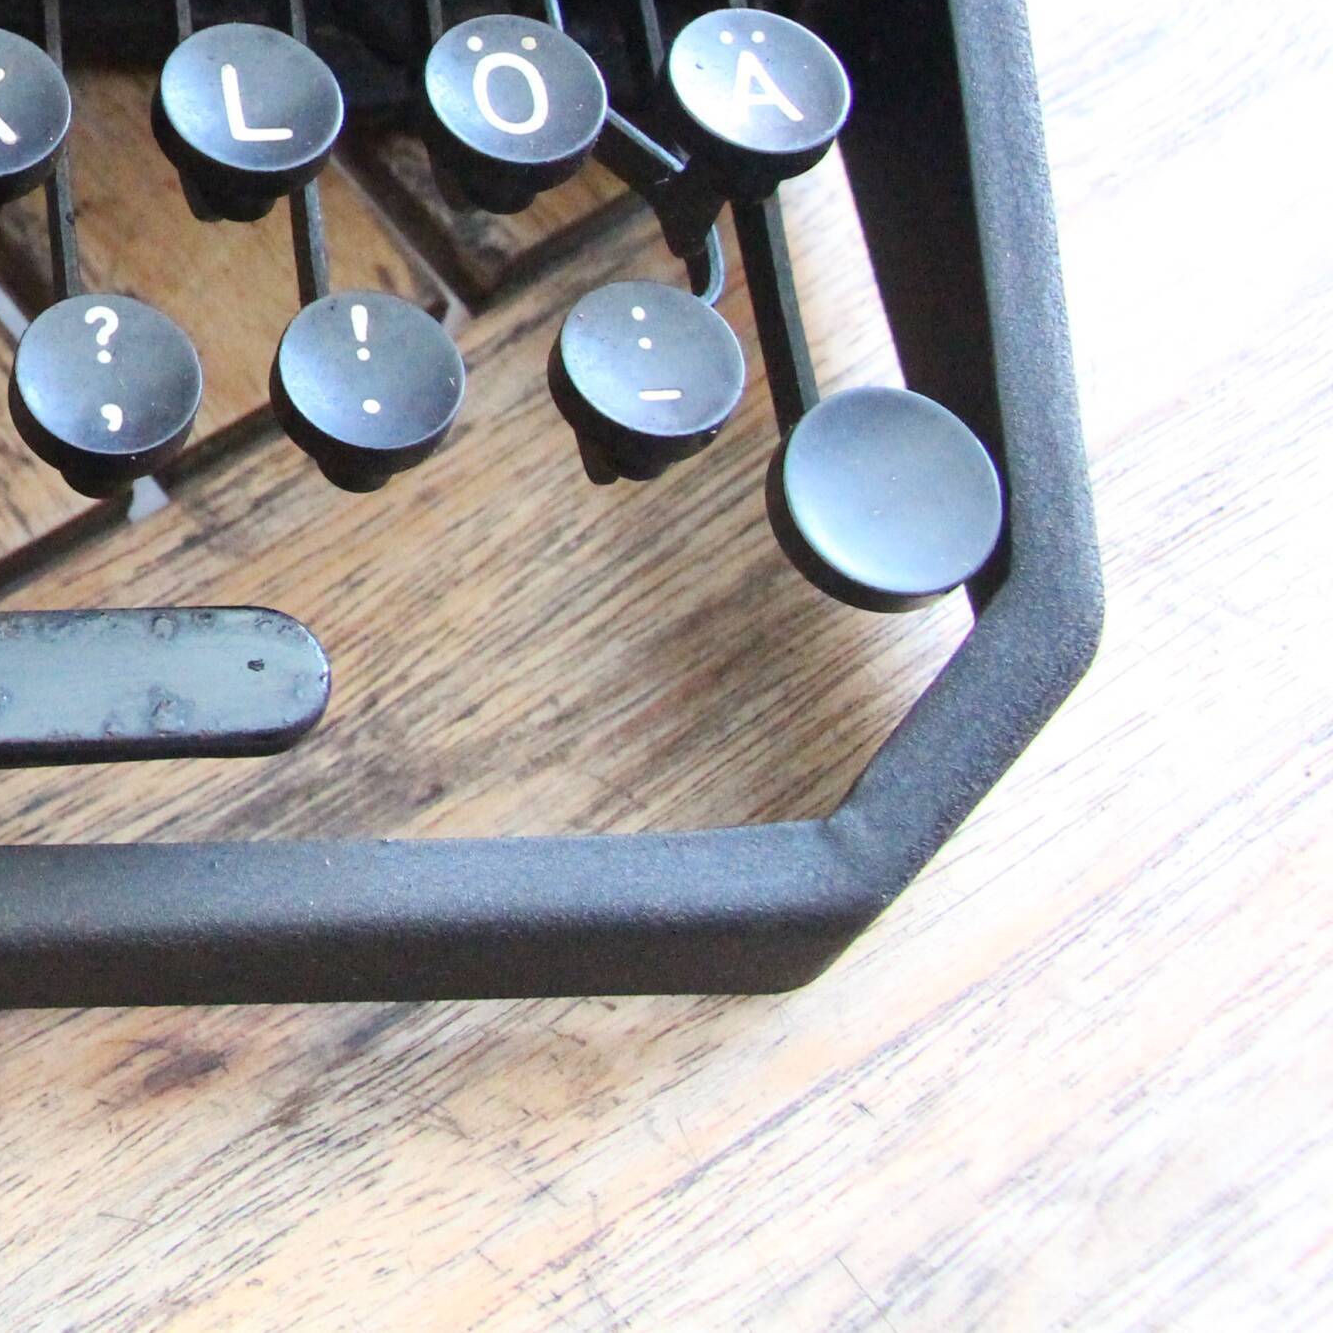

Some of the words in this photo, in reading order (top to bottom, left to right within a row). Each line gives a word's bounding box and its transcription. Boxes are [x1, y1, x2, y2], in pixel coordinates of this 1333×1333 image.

[221, 63, 295, 143] L
[467, 35, 550, 136] Ö
[719, 29, 804, 122] Ä
[83, 308, 120, 365] ?
[350, 303, 371, 362] !
